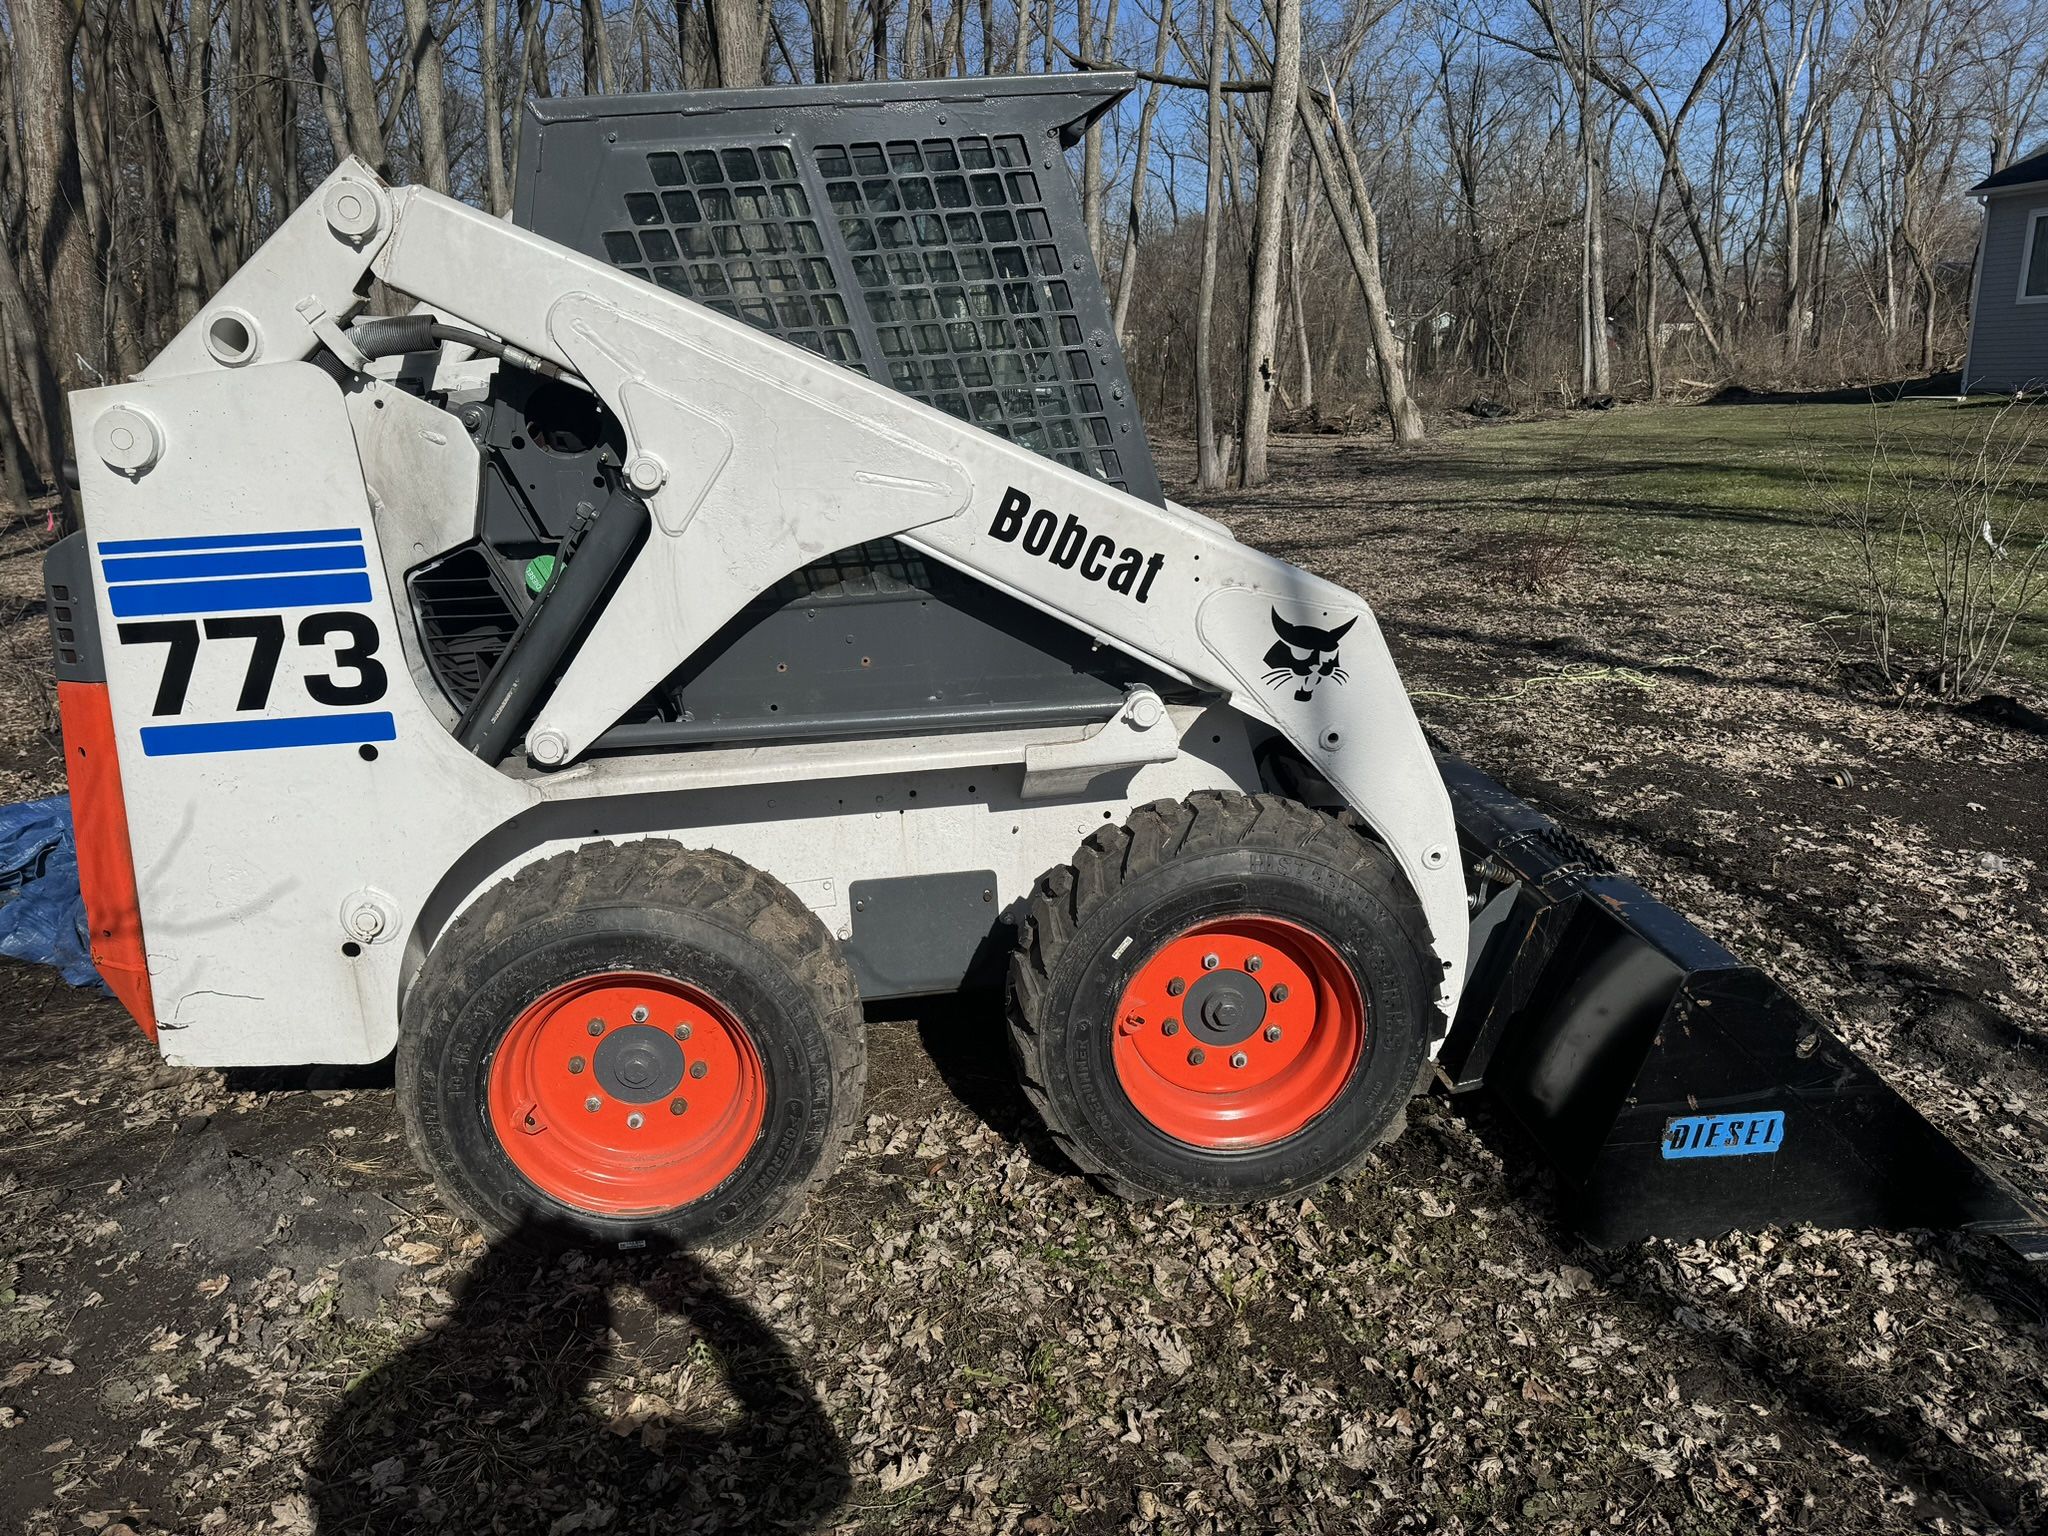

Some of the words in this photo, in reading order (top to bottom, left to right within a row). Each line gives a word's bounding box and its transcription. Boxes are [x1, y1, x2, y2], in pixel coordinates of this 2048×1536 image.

[988, 486, 1164, 603] Bobcat
[117, 611, 388, 717] 773
[1669, 1118, 1778, 1150] DIESEL
